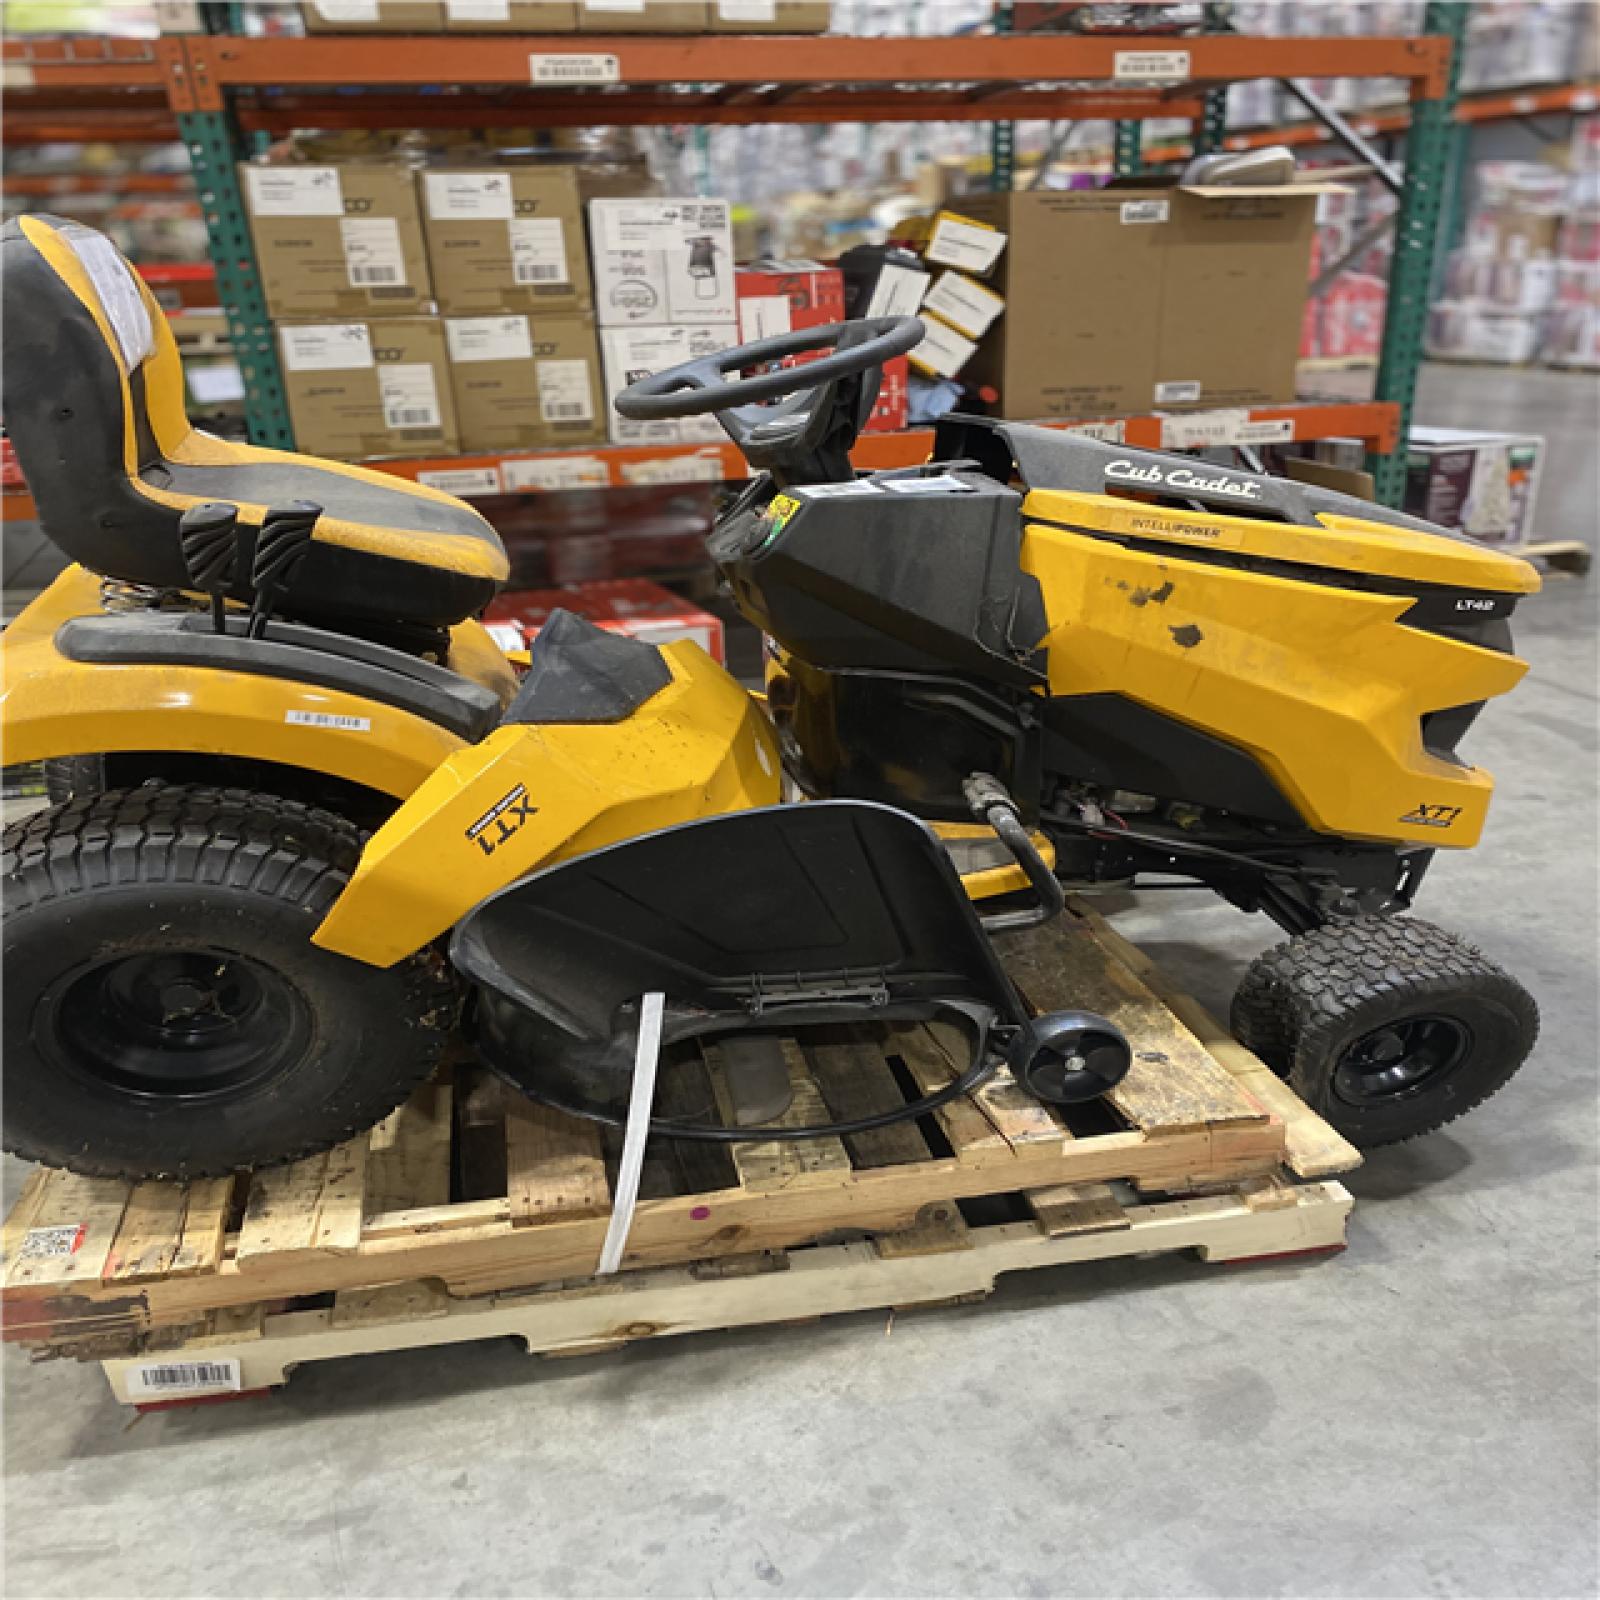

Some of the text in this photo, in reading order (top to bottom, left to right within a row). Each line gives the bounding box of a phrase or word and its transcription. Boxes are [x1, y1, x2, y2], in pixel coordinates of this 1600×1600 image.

[1104, 460, 1261, 498] Cub Cadet
[1131, 518, 1223, 539] INTELLIPOWER
[477, 794, 539, 855] XT1
[1407, 802, 1464, 821] XT1
